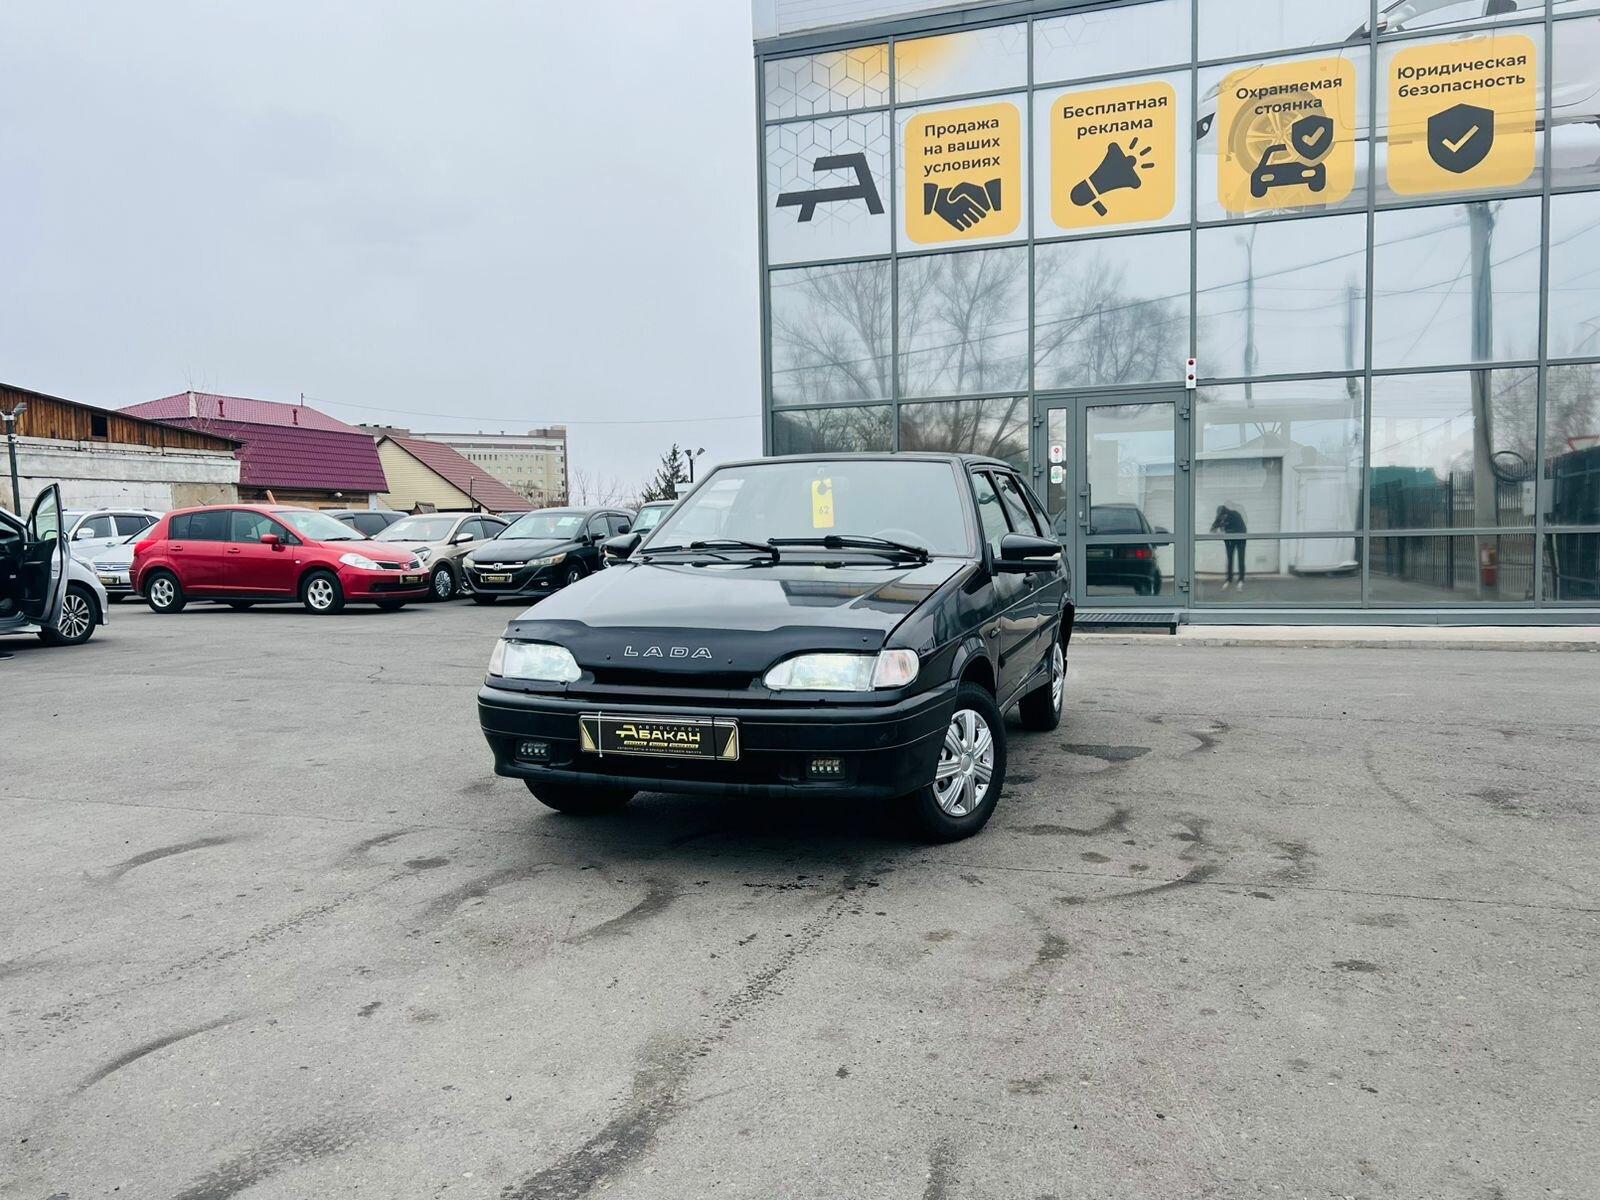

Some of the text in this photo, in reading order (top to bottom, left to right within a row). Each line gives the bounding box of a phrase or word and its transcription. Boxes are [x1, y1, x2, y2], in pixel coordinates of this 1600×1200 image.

[1397, 55, 1527, 80] Юридическая
[1236, 78, 1343, 100] Охраняемая
[1398, 74, 1526, 98] безопасность
[1063, 96, 1168, 119] Бесплатная
[1254, 98, 1323, 115] стоянка
[924, 118, 999, 139] Продажа
[1077, 118, 1153, 140] реклама
[924, 137, 1000, 156] на ваших
[923, 156, 1000, 178] условиях
[624, 646, 712, 658] LADA
